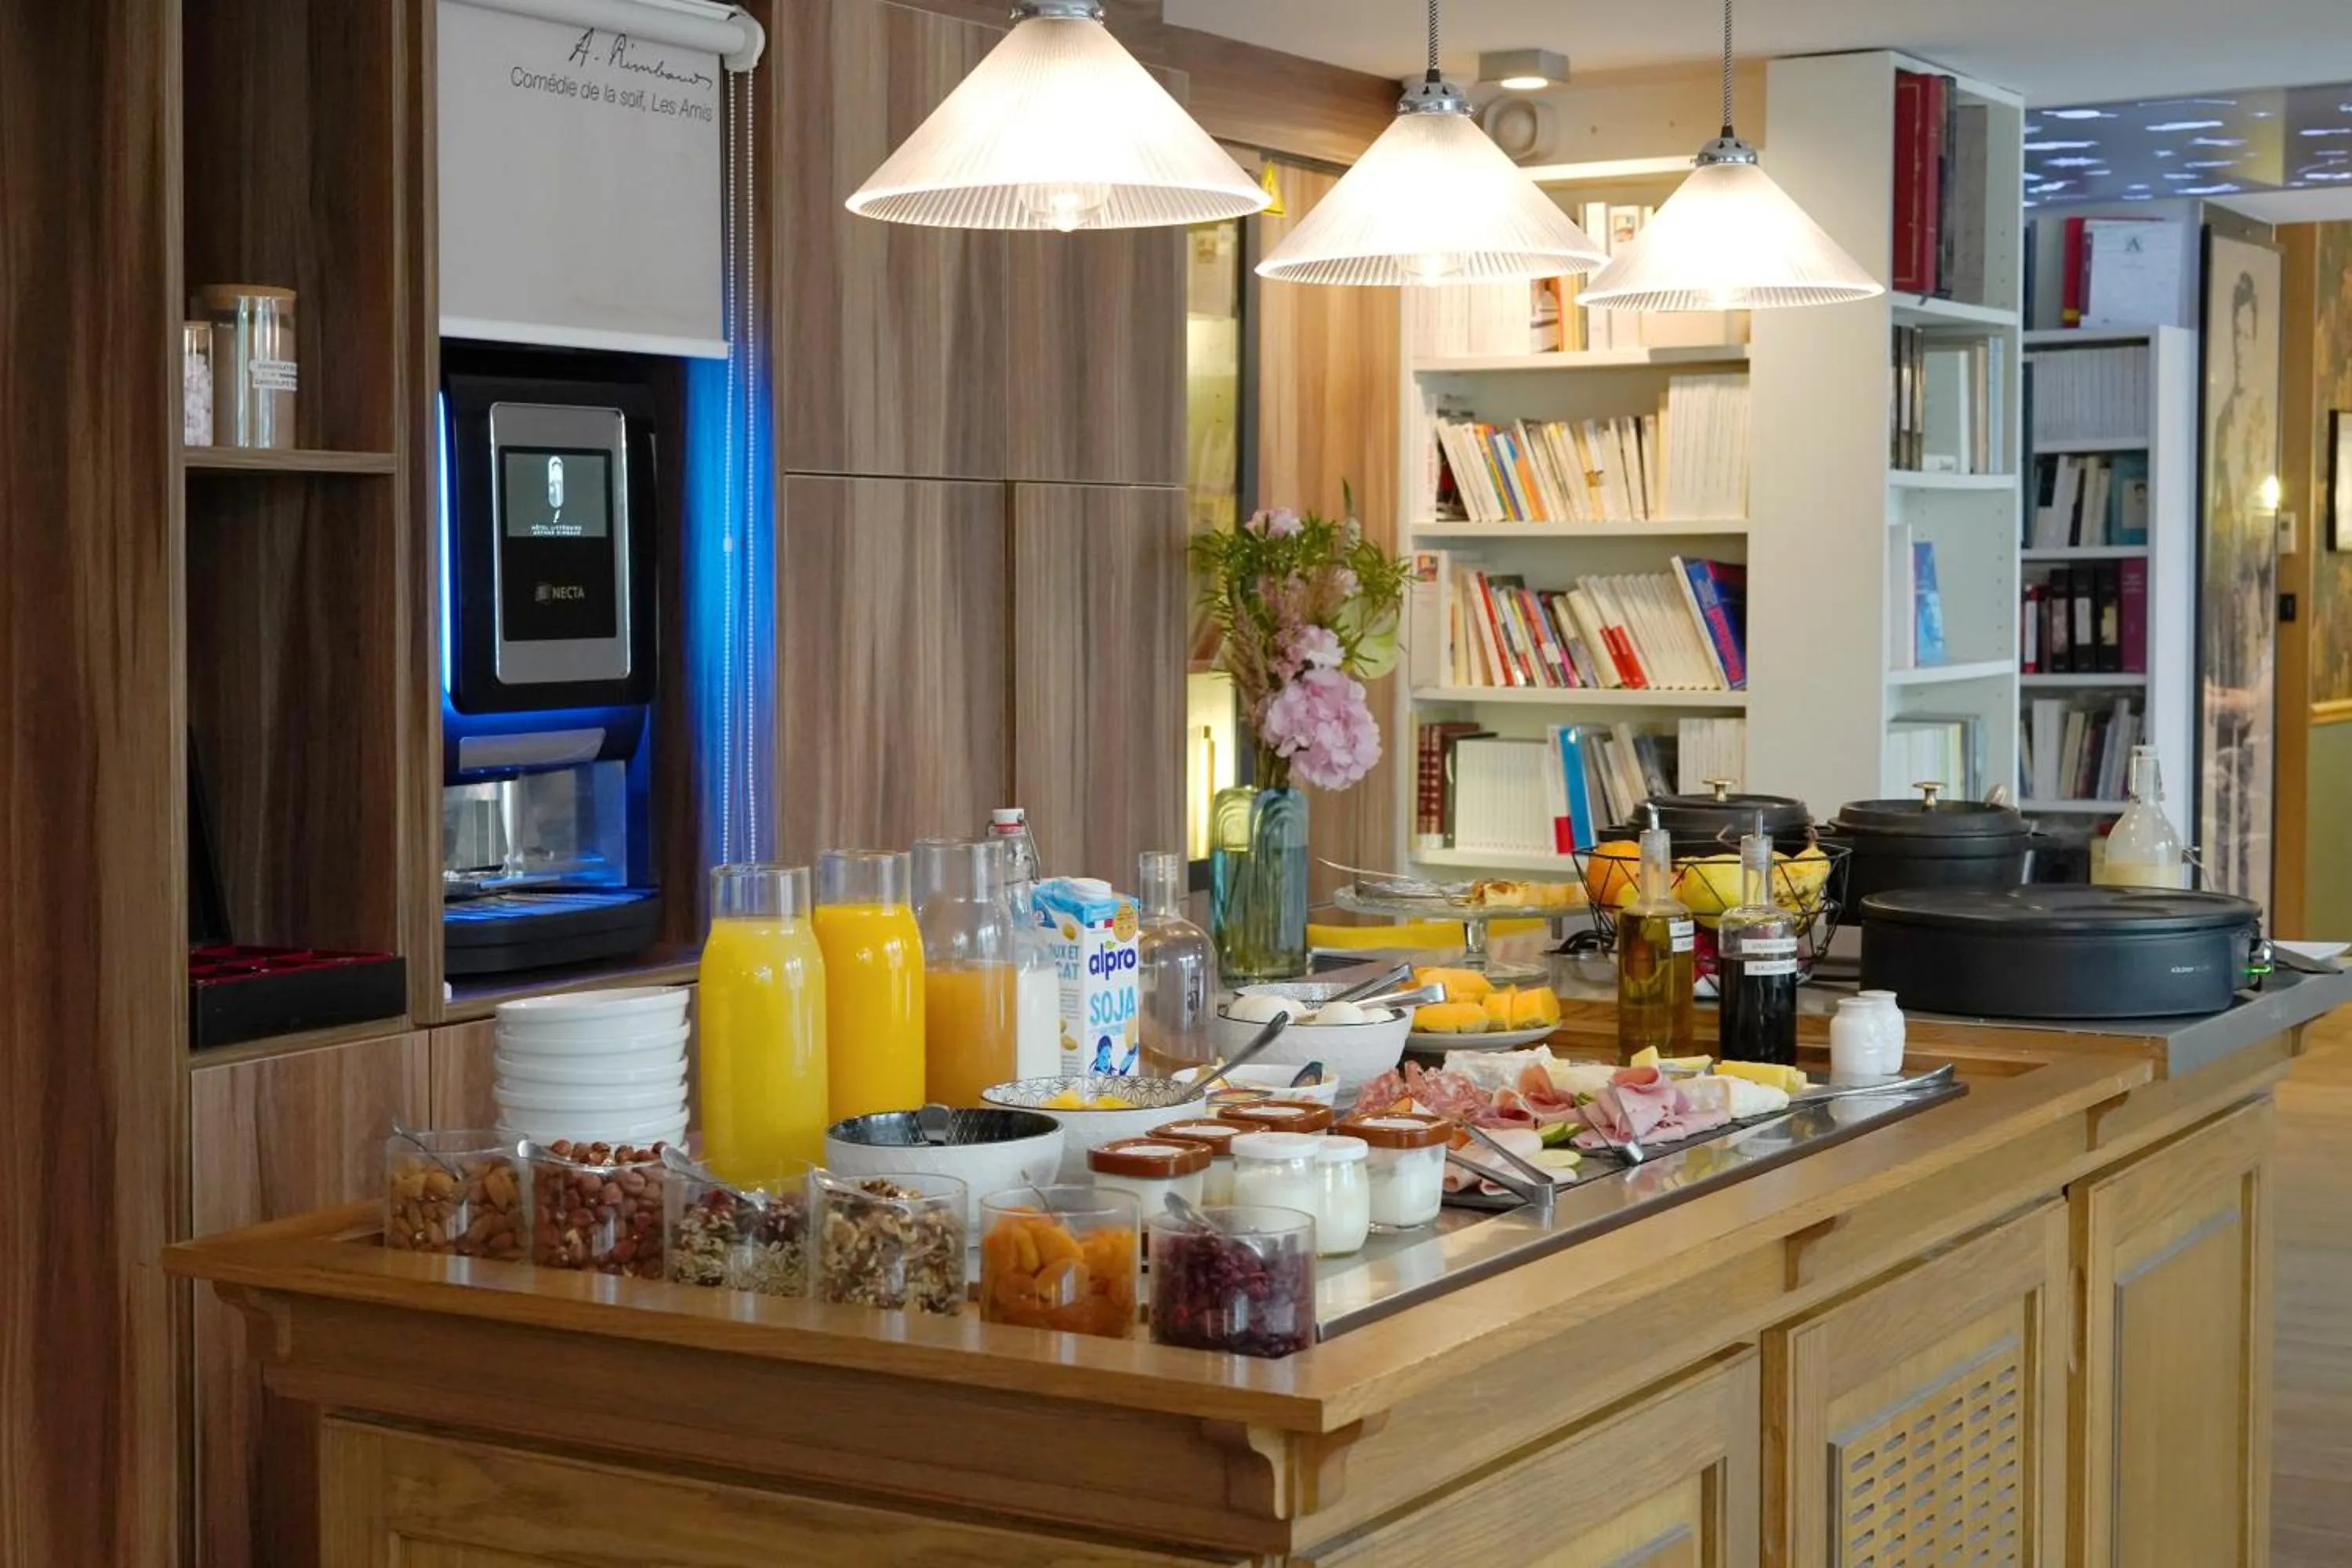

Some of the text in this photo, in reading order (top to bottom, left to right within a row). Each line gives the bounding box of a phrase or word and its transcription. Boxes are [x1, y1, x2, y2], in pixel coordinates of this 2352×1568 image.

[510, 66, 713, 123] Comédie de la soif, Les Amis
[552, 586, 585, 599] NECTA
[1089, 942, 1137, 981] alpro
[1089, 985, 1136, 1025] SOJA
